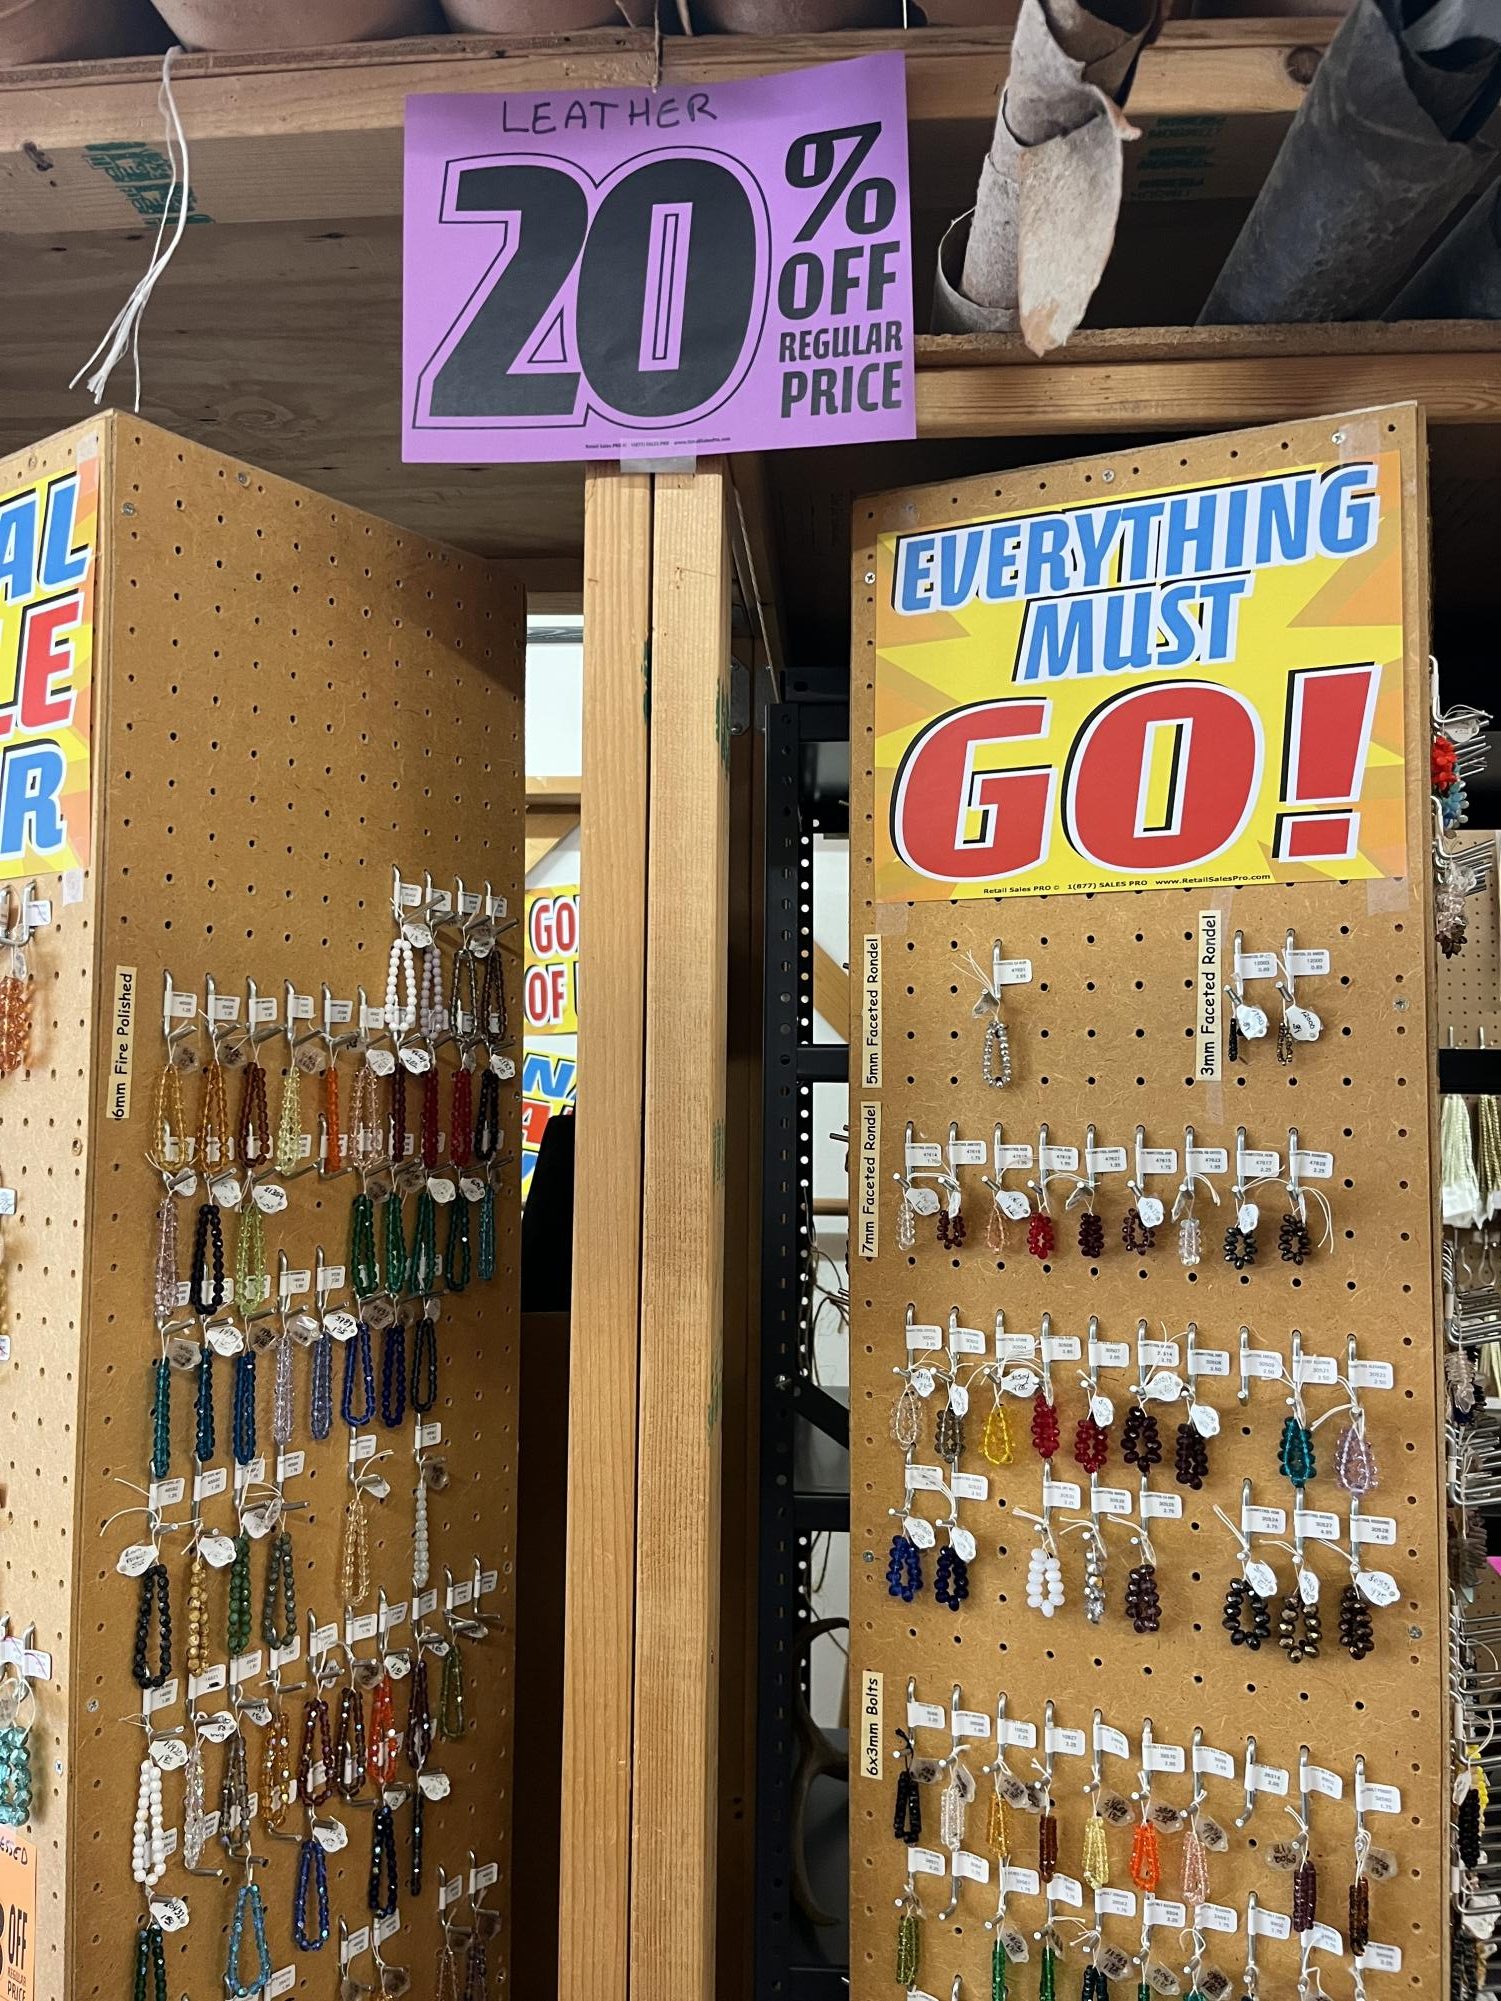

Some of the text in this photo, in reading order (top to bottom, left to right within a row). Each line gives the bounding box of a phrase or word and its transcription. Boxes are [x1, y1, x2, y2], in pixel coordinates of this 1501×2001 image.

[502, 92, 718, 135] LEATHER
[413, 145, 773, 429] 20
[778, 240, 900, 320] OFF
[779, 320, 904, 364] REGULAR
[780, 361, 903, 419] PRICE
[897, 465, 1379, 613] EVERYTHING
[1018, 574, 1250, 682] MUST
[892, 664, 1381, 882] GO!
[983, 886, 1008, 894] Retail
[1009, 885, 1031, 893] Sales
[1033, 884, 1052, 892] PRO
[1099, 880, 1127, 888] SALES
[1129, 879, 1148, 887] PRO
[1155, 873, 1271, 886] www.RetailSalesPro.com
[112, 973, 132, 1119] 6mm Fire Polished
[866, 938, 878, 1084] 5mm Faceted Rondel
[1201, 915, 1216, 1076] 3mm Faceted Rondel
[862, 1105, 876, 1253] 7mm Faceted Rondel
[866, 1678, 879, 1776] 6x3mm Bolts
[8, 1903, 28, 1970] OFF
